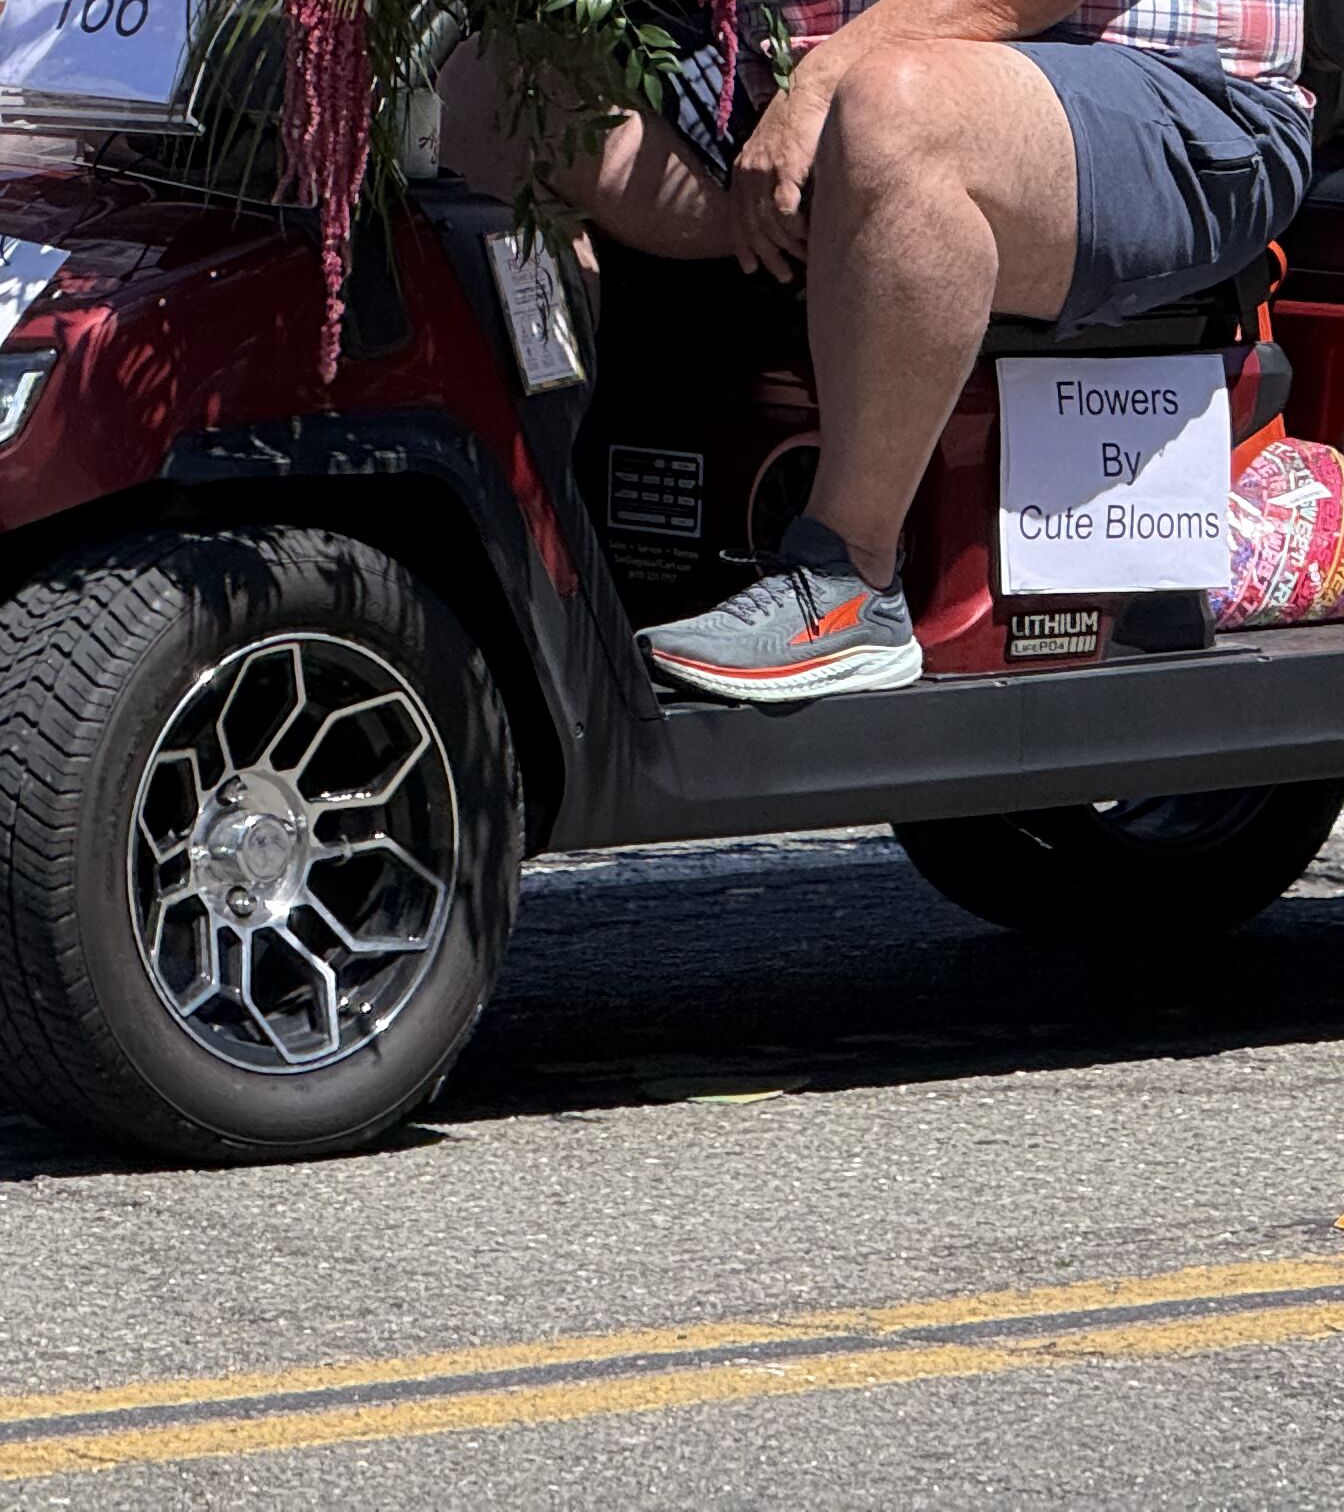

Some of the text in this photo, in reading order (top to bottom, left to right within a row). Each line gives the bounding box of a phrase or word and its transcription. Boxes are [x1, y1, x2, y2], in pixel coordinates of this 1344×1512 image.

[1055, 380, 1180, 416] Flowers
[1101, 442, 1141, 486] By
[1019, 503, 1220, 541] Cute Blooms
[1011, 610, 1099, 637] LITHIUM
